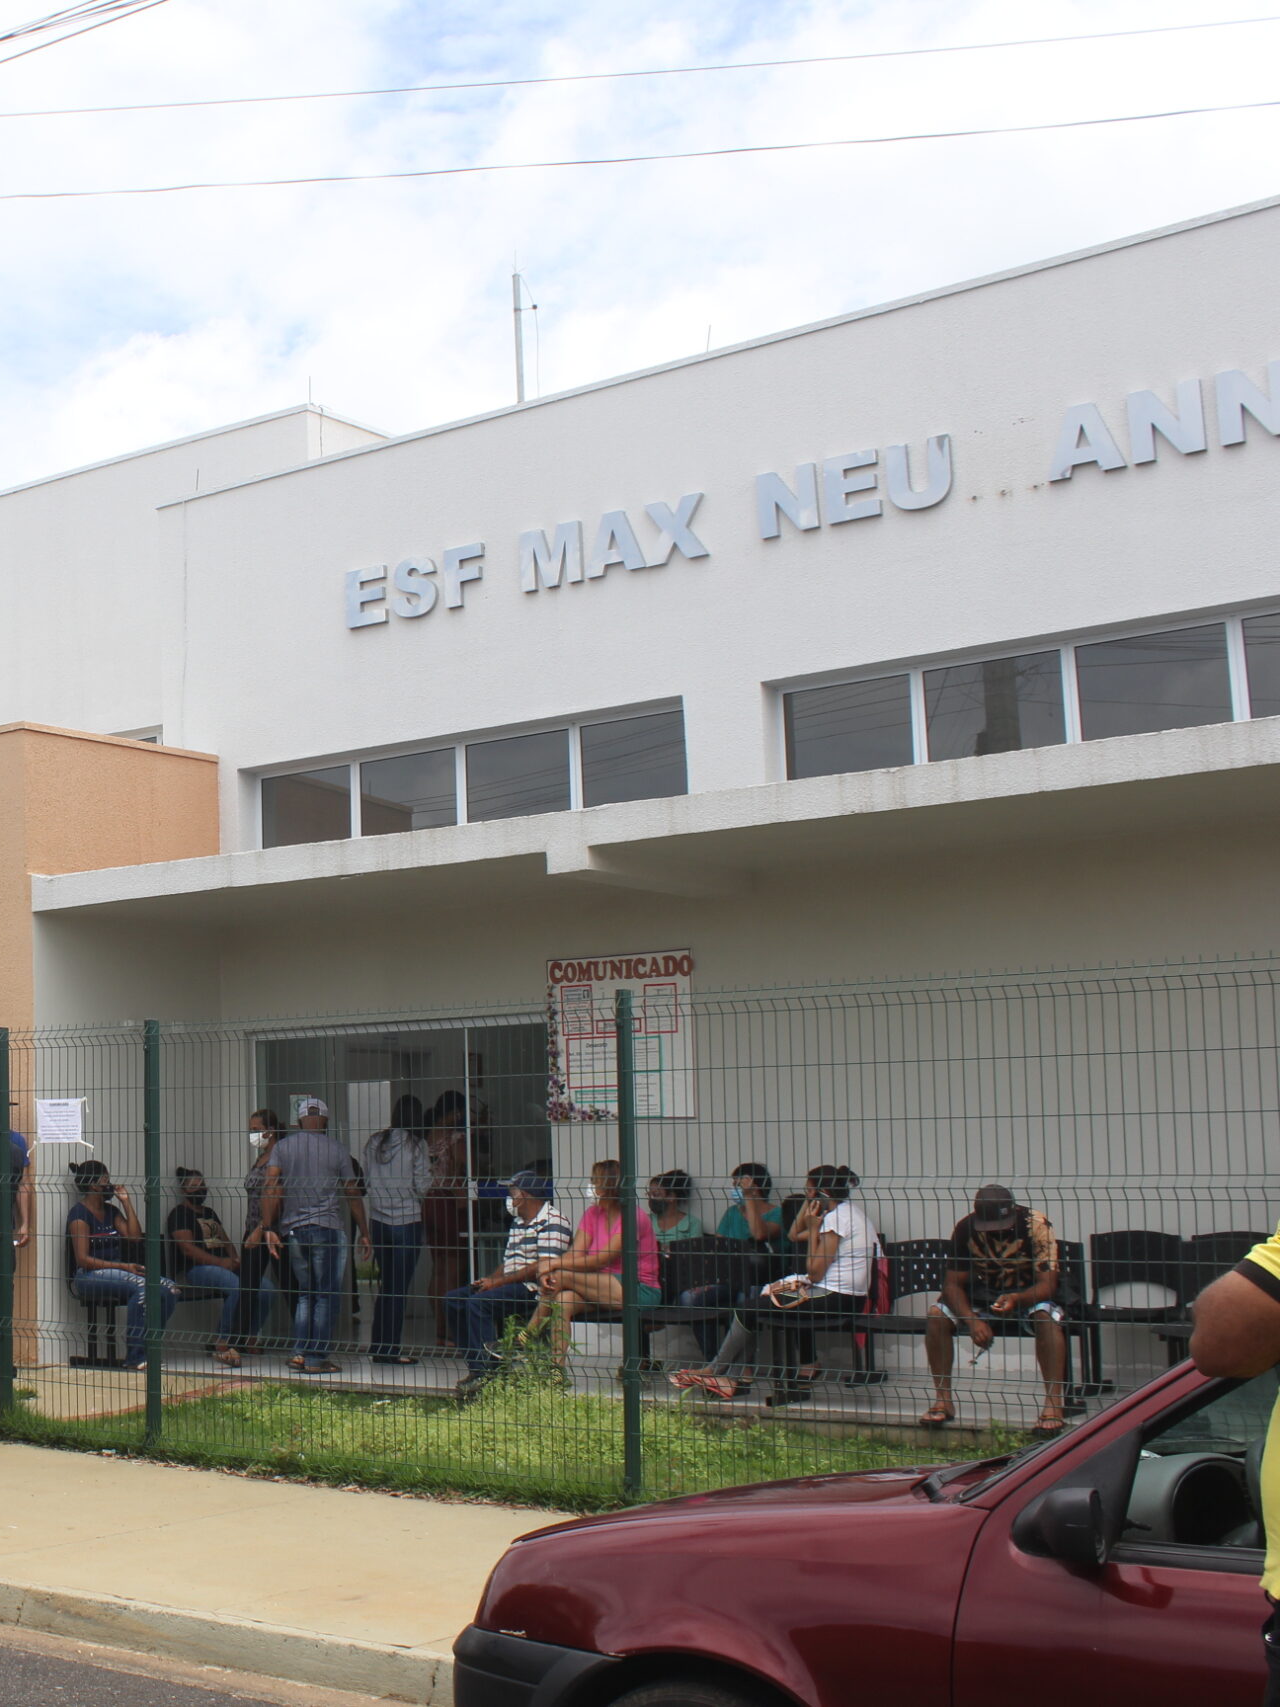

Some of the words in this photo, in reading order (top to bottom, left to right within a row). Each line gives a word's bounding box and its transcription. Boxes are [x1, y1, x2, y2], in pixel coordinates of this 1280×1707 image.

[345, 542, 485, 630] ESF
[520, 491, 710, 593] MAX
[755, 433, 954, 540] NEU
[549, 954, 694, 984] COMUNICADO
